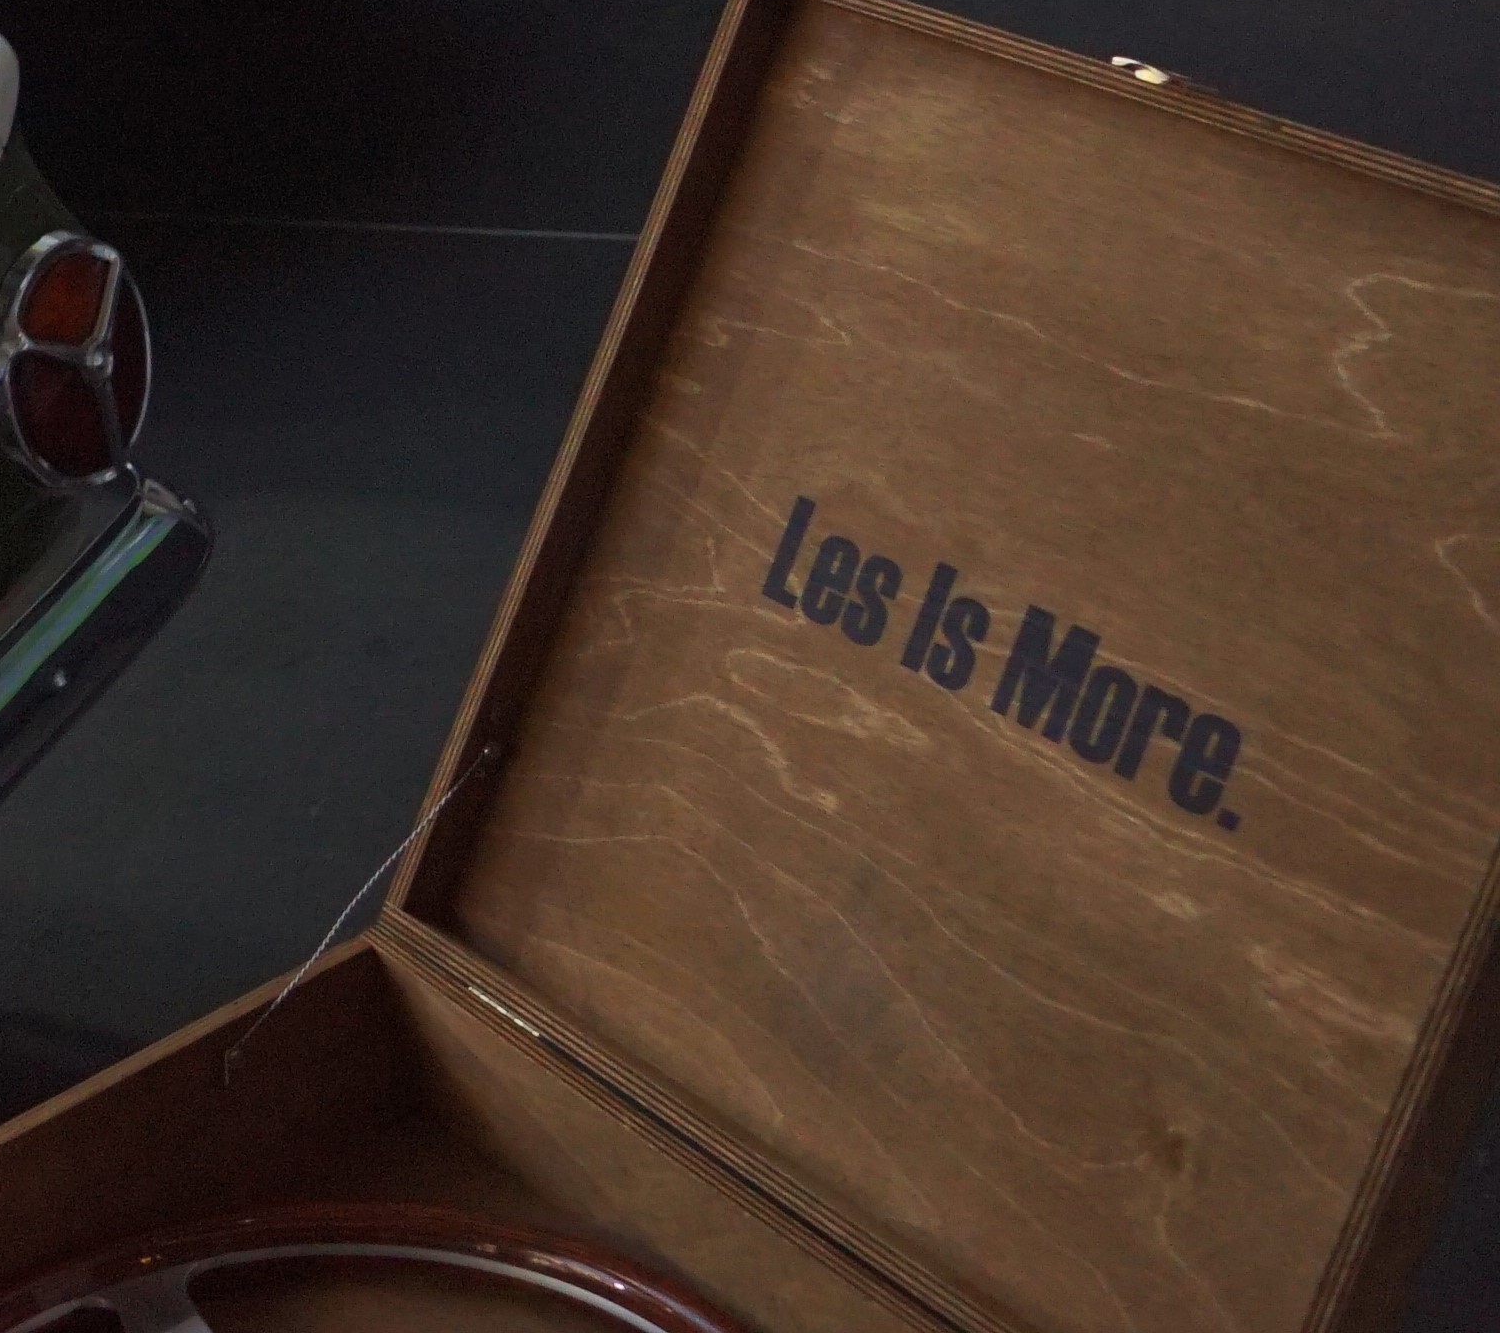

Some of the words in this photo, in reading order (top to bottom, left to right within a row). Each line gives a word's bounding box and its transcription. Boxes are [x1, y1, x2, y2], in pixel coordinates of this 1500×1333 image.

[761, 494, 902, 647] Les
[900, 562, 992, 691] Is
[990, 604, 1244, 833] More.
